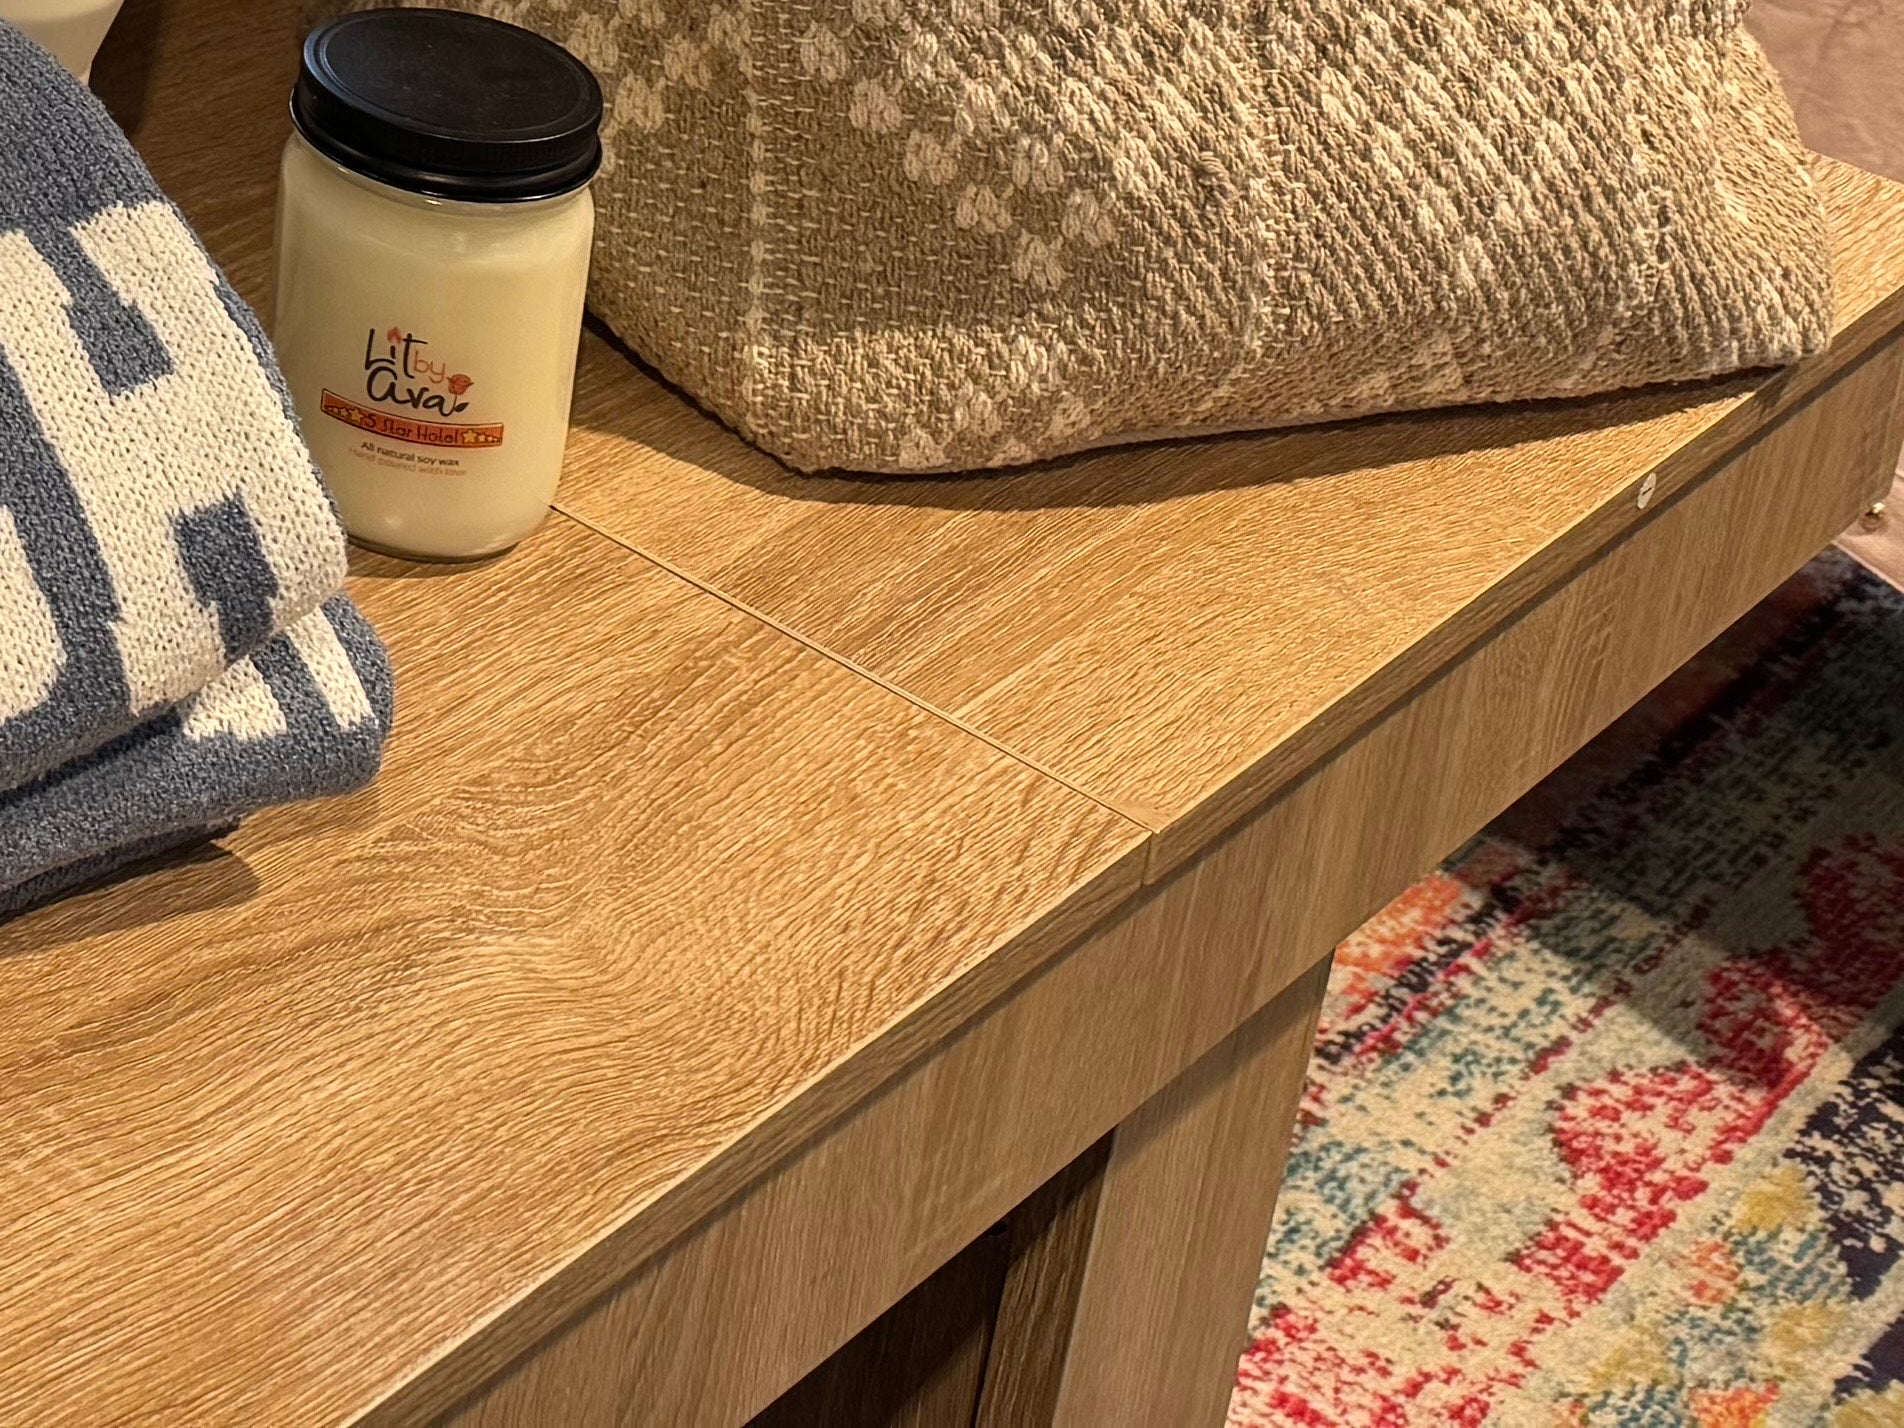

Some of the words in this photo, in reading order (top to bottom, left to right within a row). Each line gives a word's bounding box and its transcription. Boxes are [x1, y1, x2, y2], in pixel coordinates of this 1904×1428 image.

[364, 326, 429, 380] Lit
[412, 350, 446, 384] by
[376, 445, 416, 462] natural
[417, 455, 437, 466] soy
